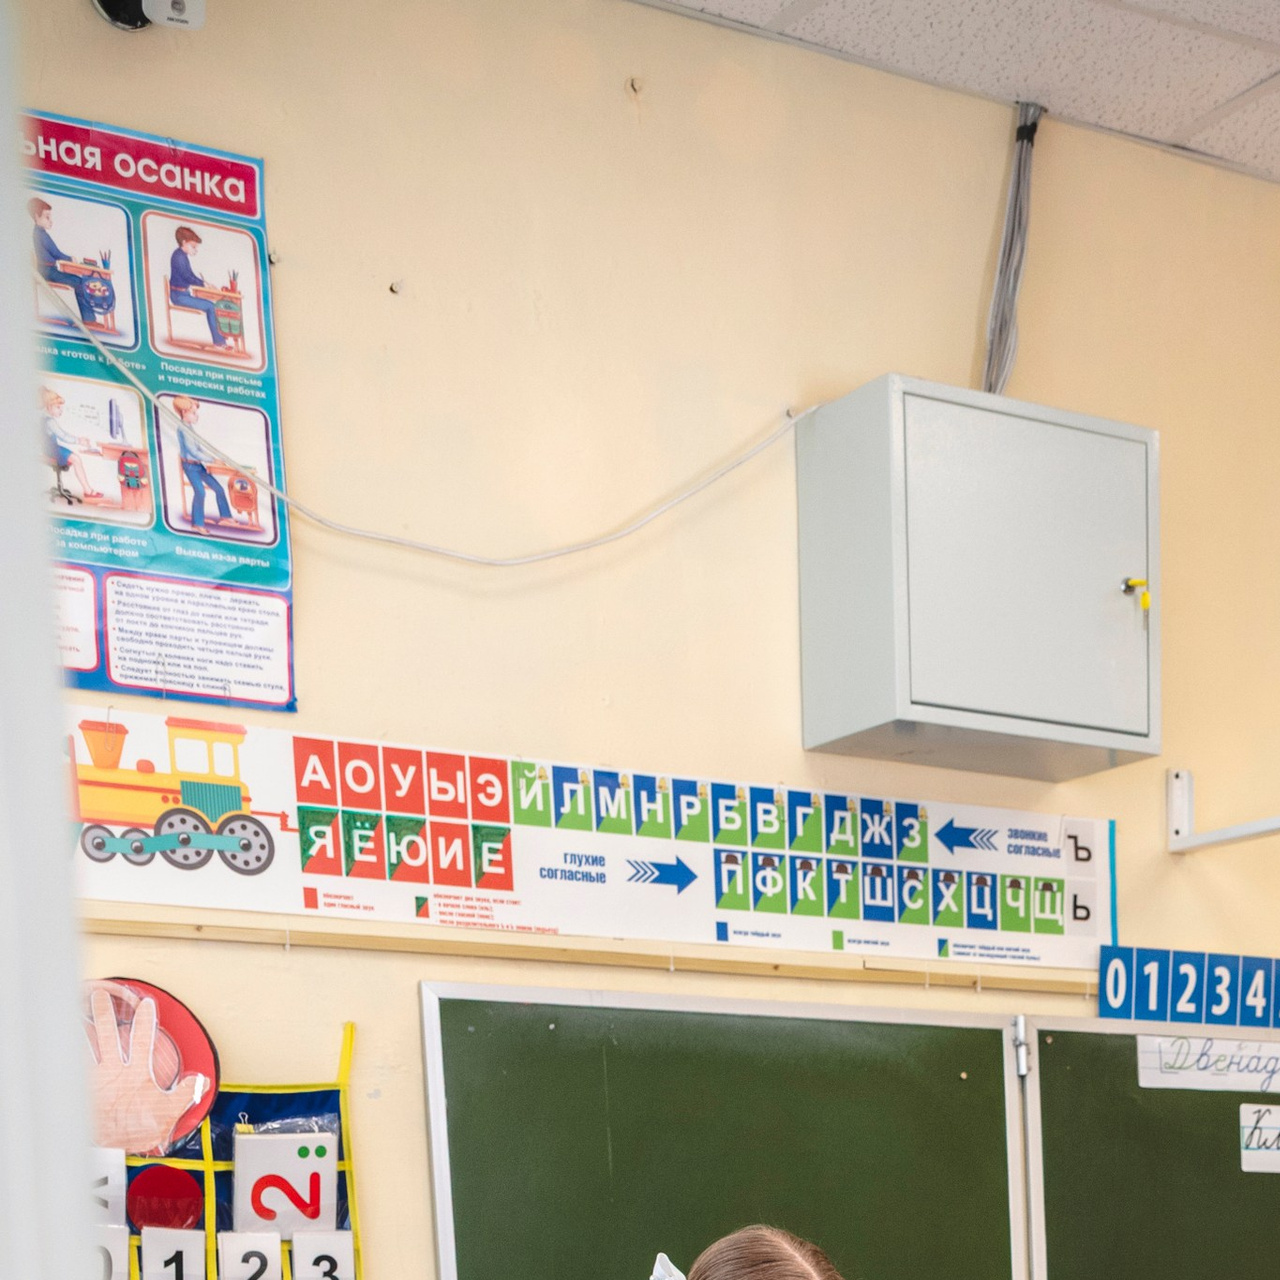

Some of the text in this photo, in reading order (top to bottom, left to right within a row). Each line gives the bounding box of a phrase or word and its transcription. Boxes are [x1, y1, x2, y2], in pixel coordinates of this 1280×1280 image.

[114, 153, 245, 203] осанка
[161, 362, 262, 387] Посадка при письме
[167, 376, 224, 392] творческих
[227, 384, 266, 399] работах
[68, 541, 139, 558] компьютером
[90, 531, 109, 543] при
[112, 535, 148, 548] работе
[175, 545, 270, 568] Выход из-за парты
[300, 754, 921, 848] А О У Ы Э Й Л М Н Р Б В Г Д Ж З
[1007, 828, 1048, 842] звонкие
[308, 821, 505, 874] Я Ё Ю И Е
[1007, 844, 1061, 859] согласные
[563, 852, 605, 867] глухие
[539, 867, 607, 884] согласные
[721, 864, 1063, 926] П Ф К Т Ш С Х Ц Ч Щ
[1105, 958, 1127, 1009] 0
[1143, 961, 1159, 1011] 1
[1176, 963, 1197, 1013] 2
[1211, 966, 1231, 1016] 3
[1245, 969, 1266, 1018] 4
[251, 1171, 321, 1221] 2
